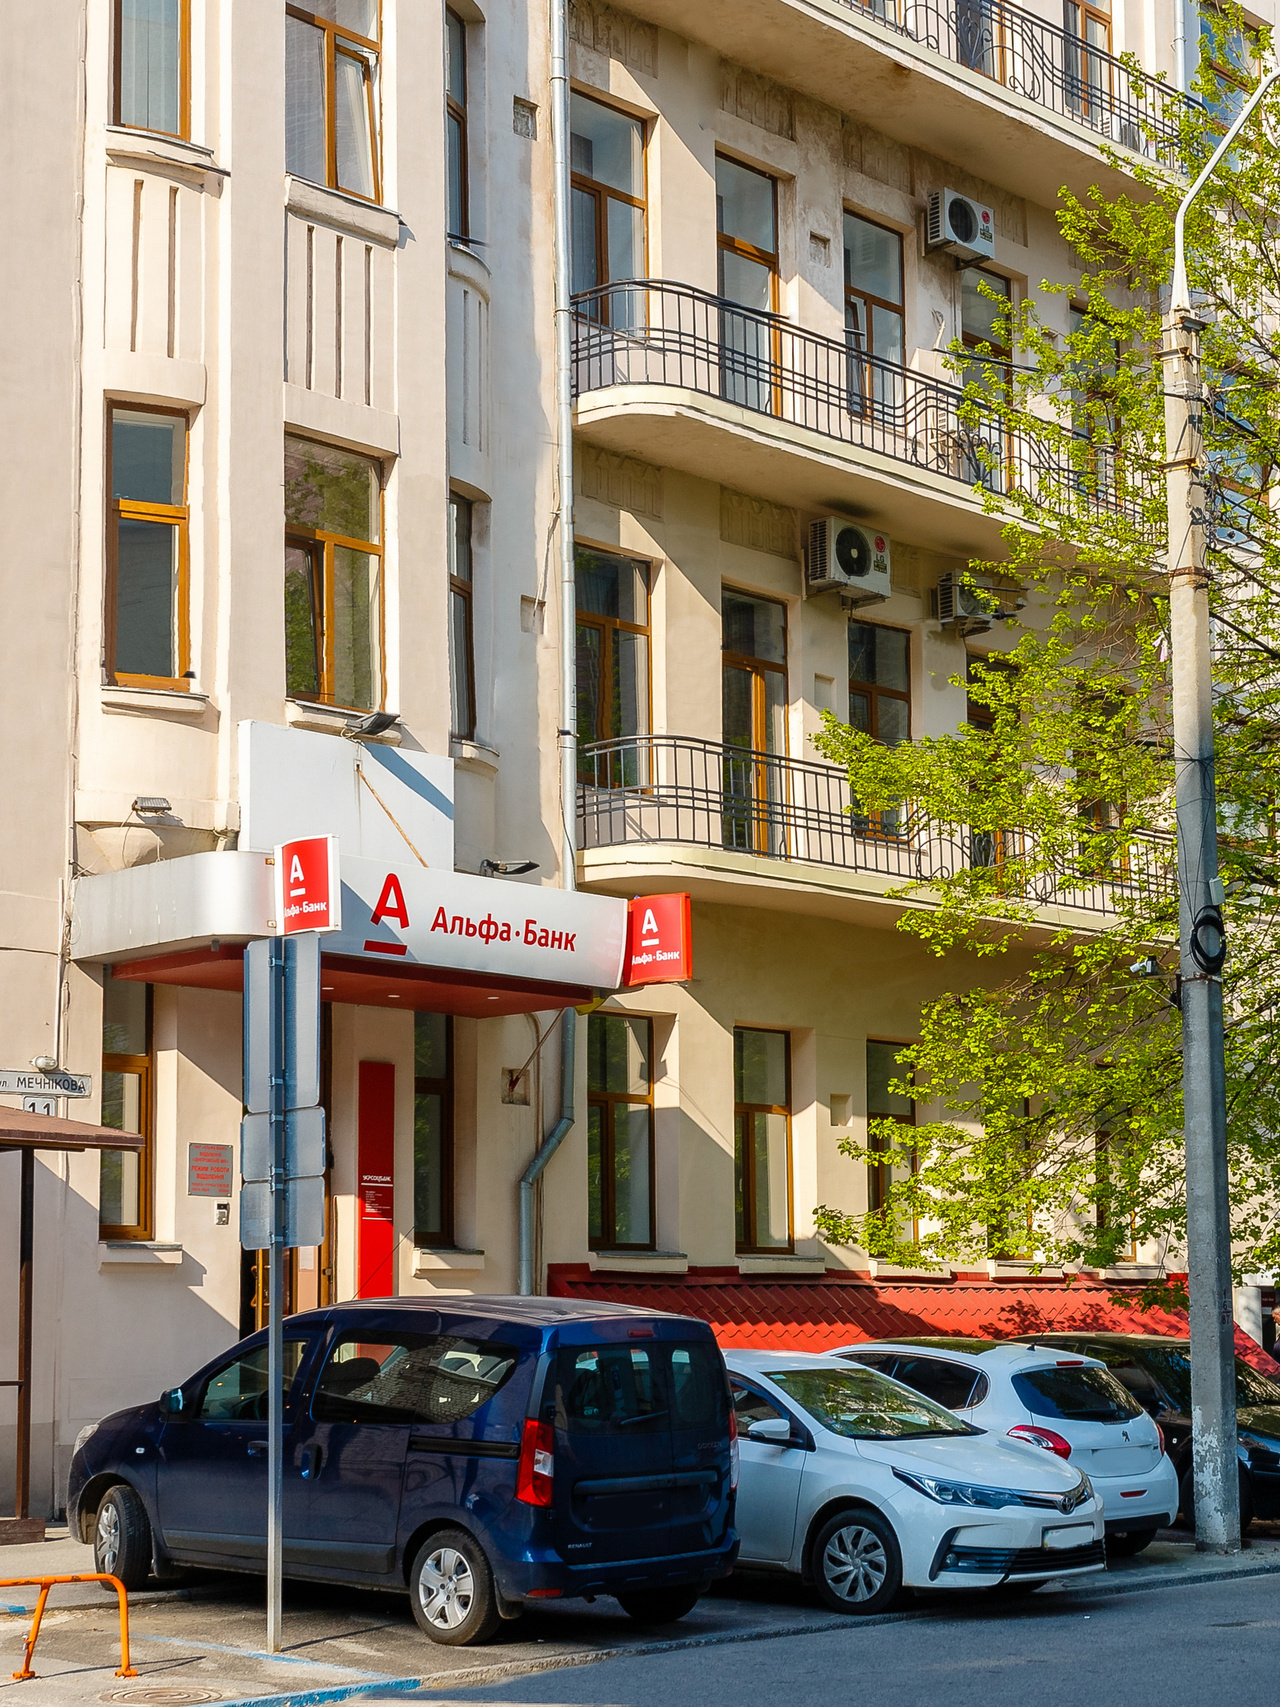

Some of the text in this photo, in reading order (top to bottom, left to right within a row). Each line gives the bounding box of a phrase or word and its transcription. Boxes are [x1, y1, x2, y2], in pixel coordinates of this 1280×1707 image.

[370, 873, 410, 929] А
[16, 1076, 86, 1092] МЕЧНІКОВА
[28, 1102, 51, 1116] 11
